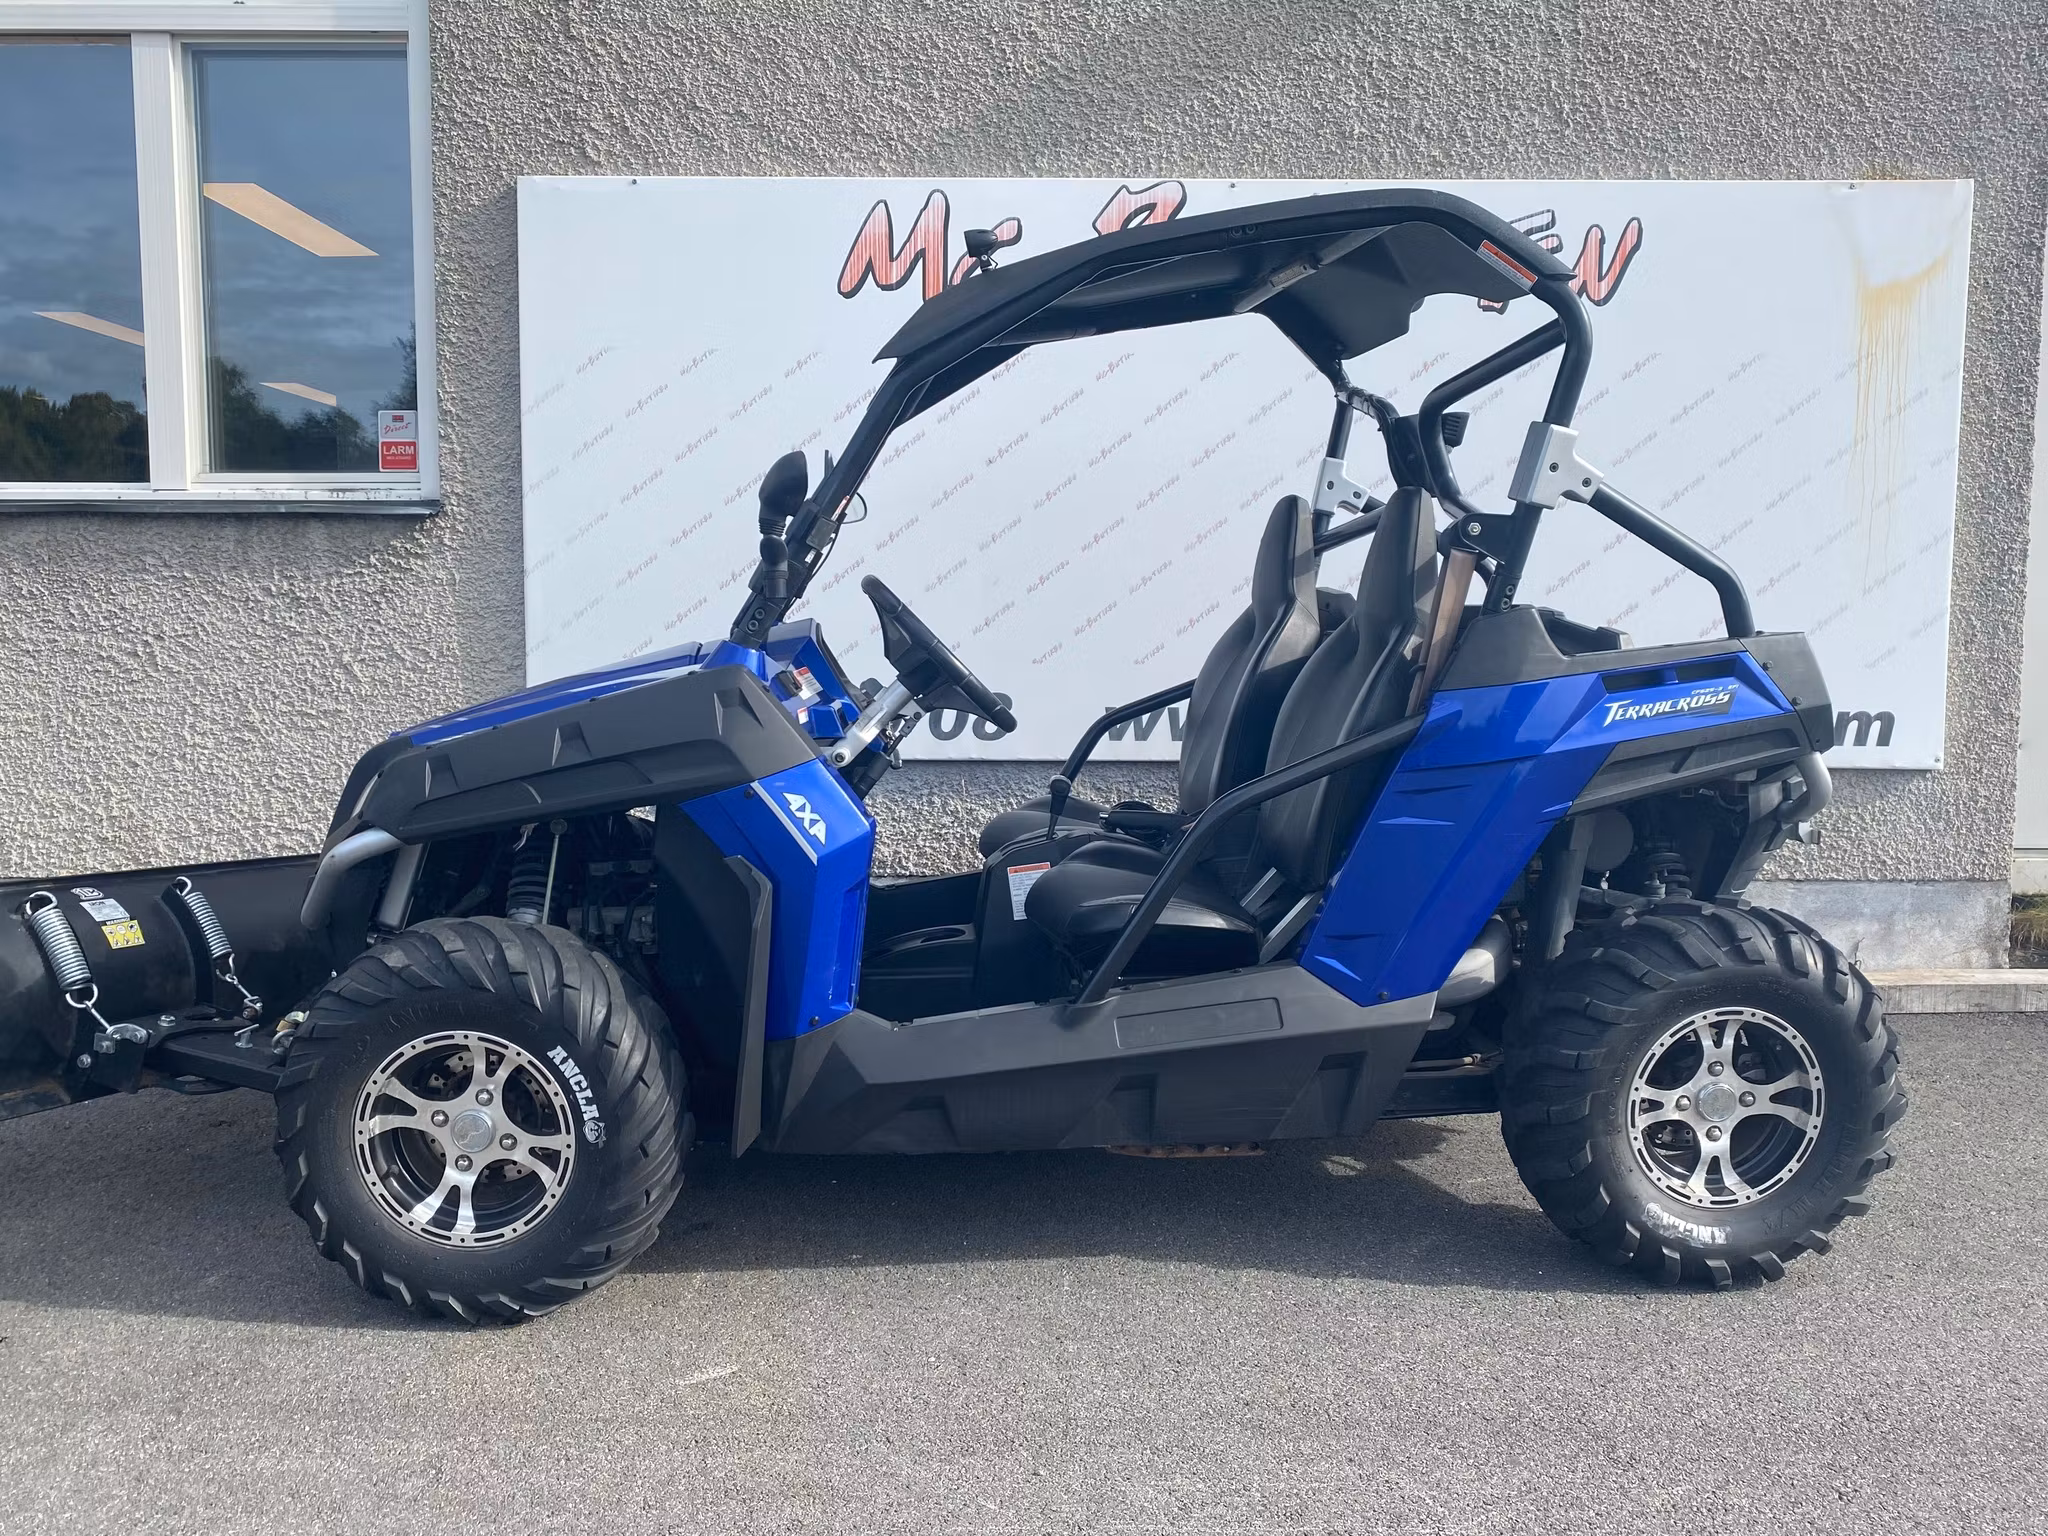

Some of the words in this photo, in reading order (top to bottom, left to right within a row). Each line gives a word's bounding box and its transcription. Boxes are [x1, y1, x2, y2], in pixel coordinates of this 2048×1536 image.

[383, 445, 414, 455] LARM
[1602, 690, 1731, 728] TERRACROSS
[546, 1045, 600, 1121] ANCLA
